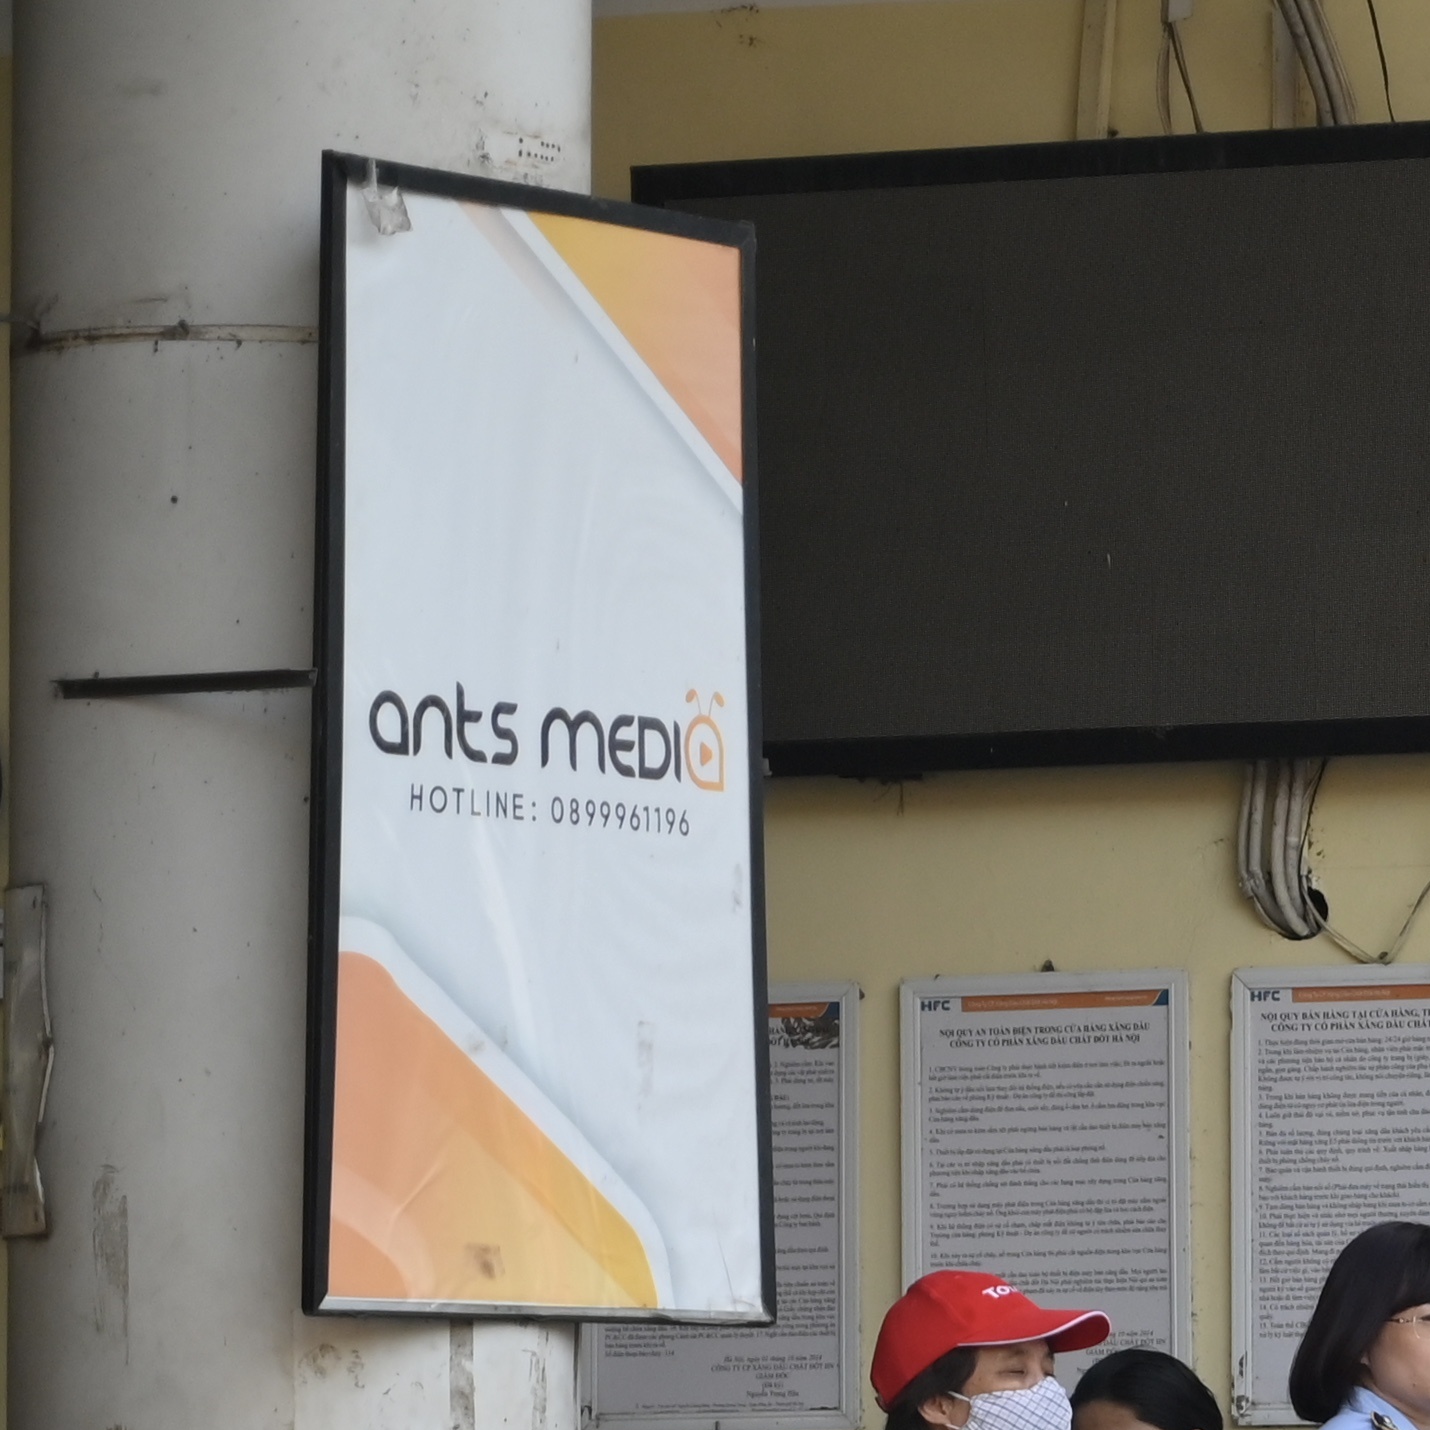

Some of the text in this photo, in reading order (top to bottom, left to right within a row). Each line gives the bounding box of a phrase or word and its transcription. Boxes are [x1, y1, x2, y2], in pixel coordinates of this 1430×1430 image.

[369, 680, 519, 766] ants
[410, 783, 690, 837] HOTLINE: 0899961196
[921, 1001, 950, 1011] HFC
[1251, 990, 1280, 1002] HFC
